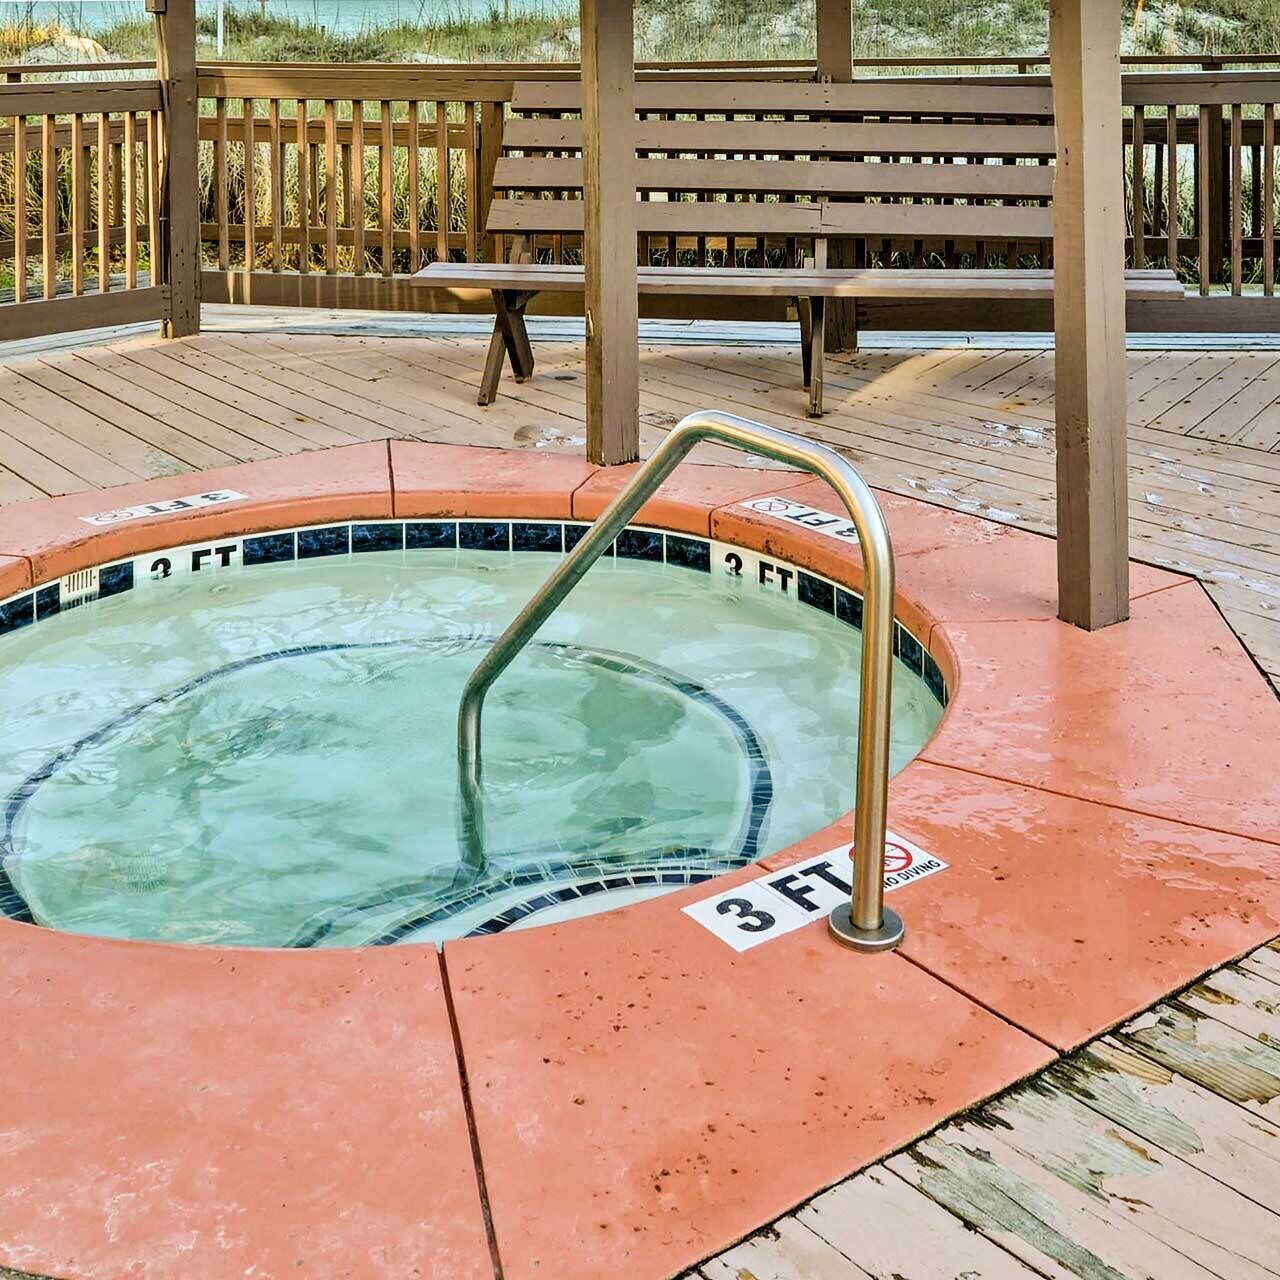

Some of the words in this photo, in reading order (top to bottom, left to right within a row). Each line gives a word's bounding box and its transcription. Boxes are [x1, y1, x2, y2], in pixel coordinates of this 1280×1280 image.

[151, 558, 172, 580] 3
[192, 544, 237, 572] FT
[724, 553, 743, 576] 3
[759, 560, 793, 592] FT
[897, 860, 941, 880] DIVING
[716, 898, 776, 933] 3
[767, 861, 852, 913] FT
